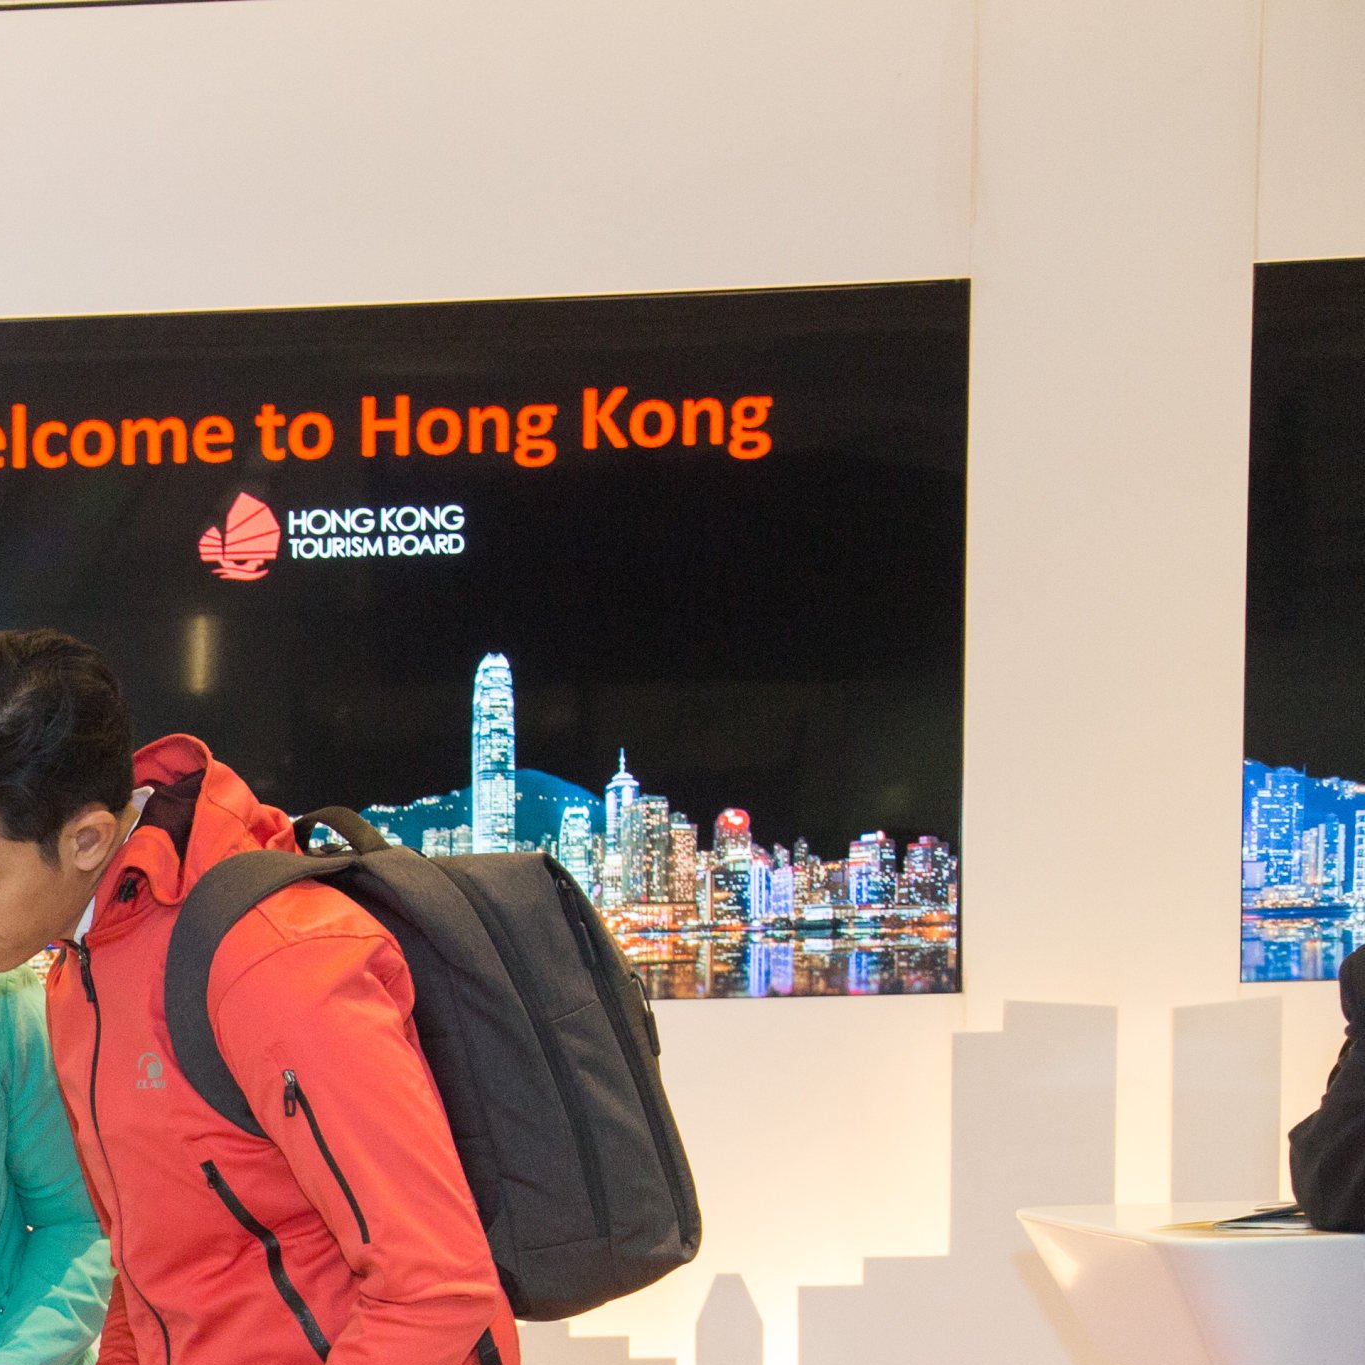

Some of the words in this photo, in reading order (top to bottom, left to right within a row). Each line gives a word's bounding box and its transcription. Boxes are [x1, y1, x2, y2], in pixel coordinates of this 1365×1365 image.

[255, 401, 334, 463] to
[360, 394, 559, 468] Hong
[582, 386, 774, 460] Kong
[288, 509, 375, 535] HONG
[380, 505, 465, 532] KONG
[289, 536, 384, 560] TOURISM
[387, 533, 465, 556] BOARD
